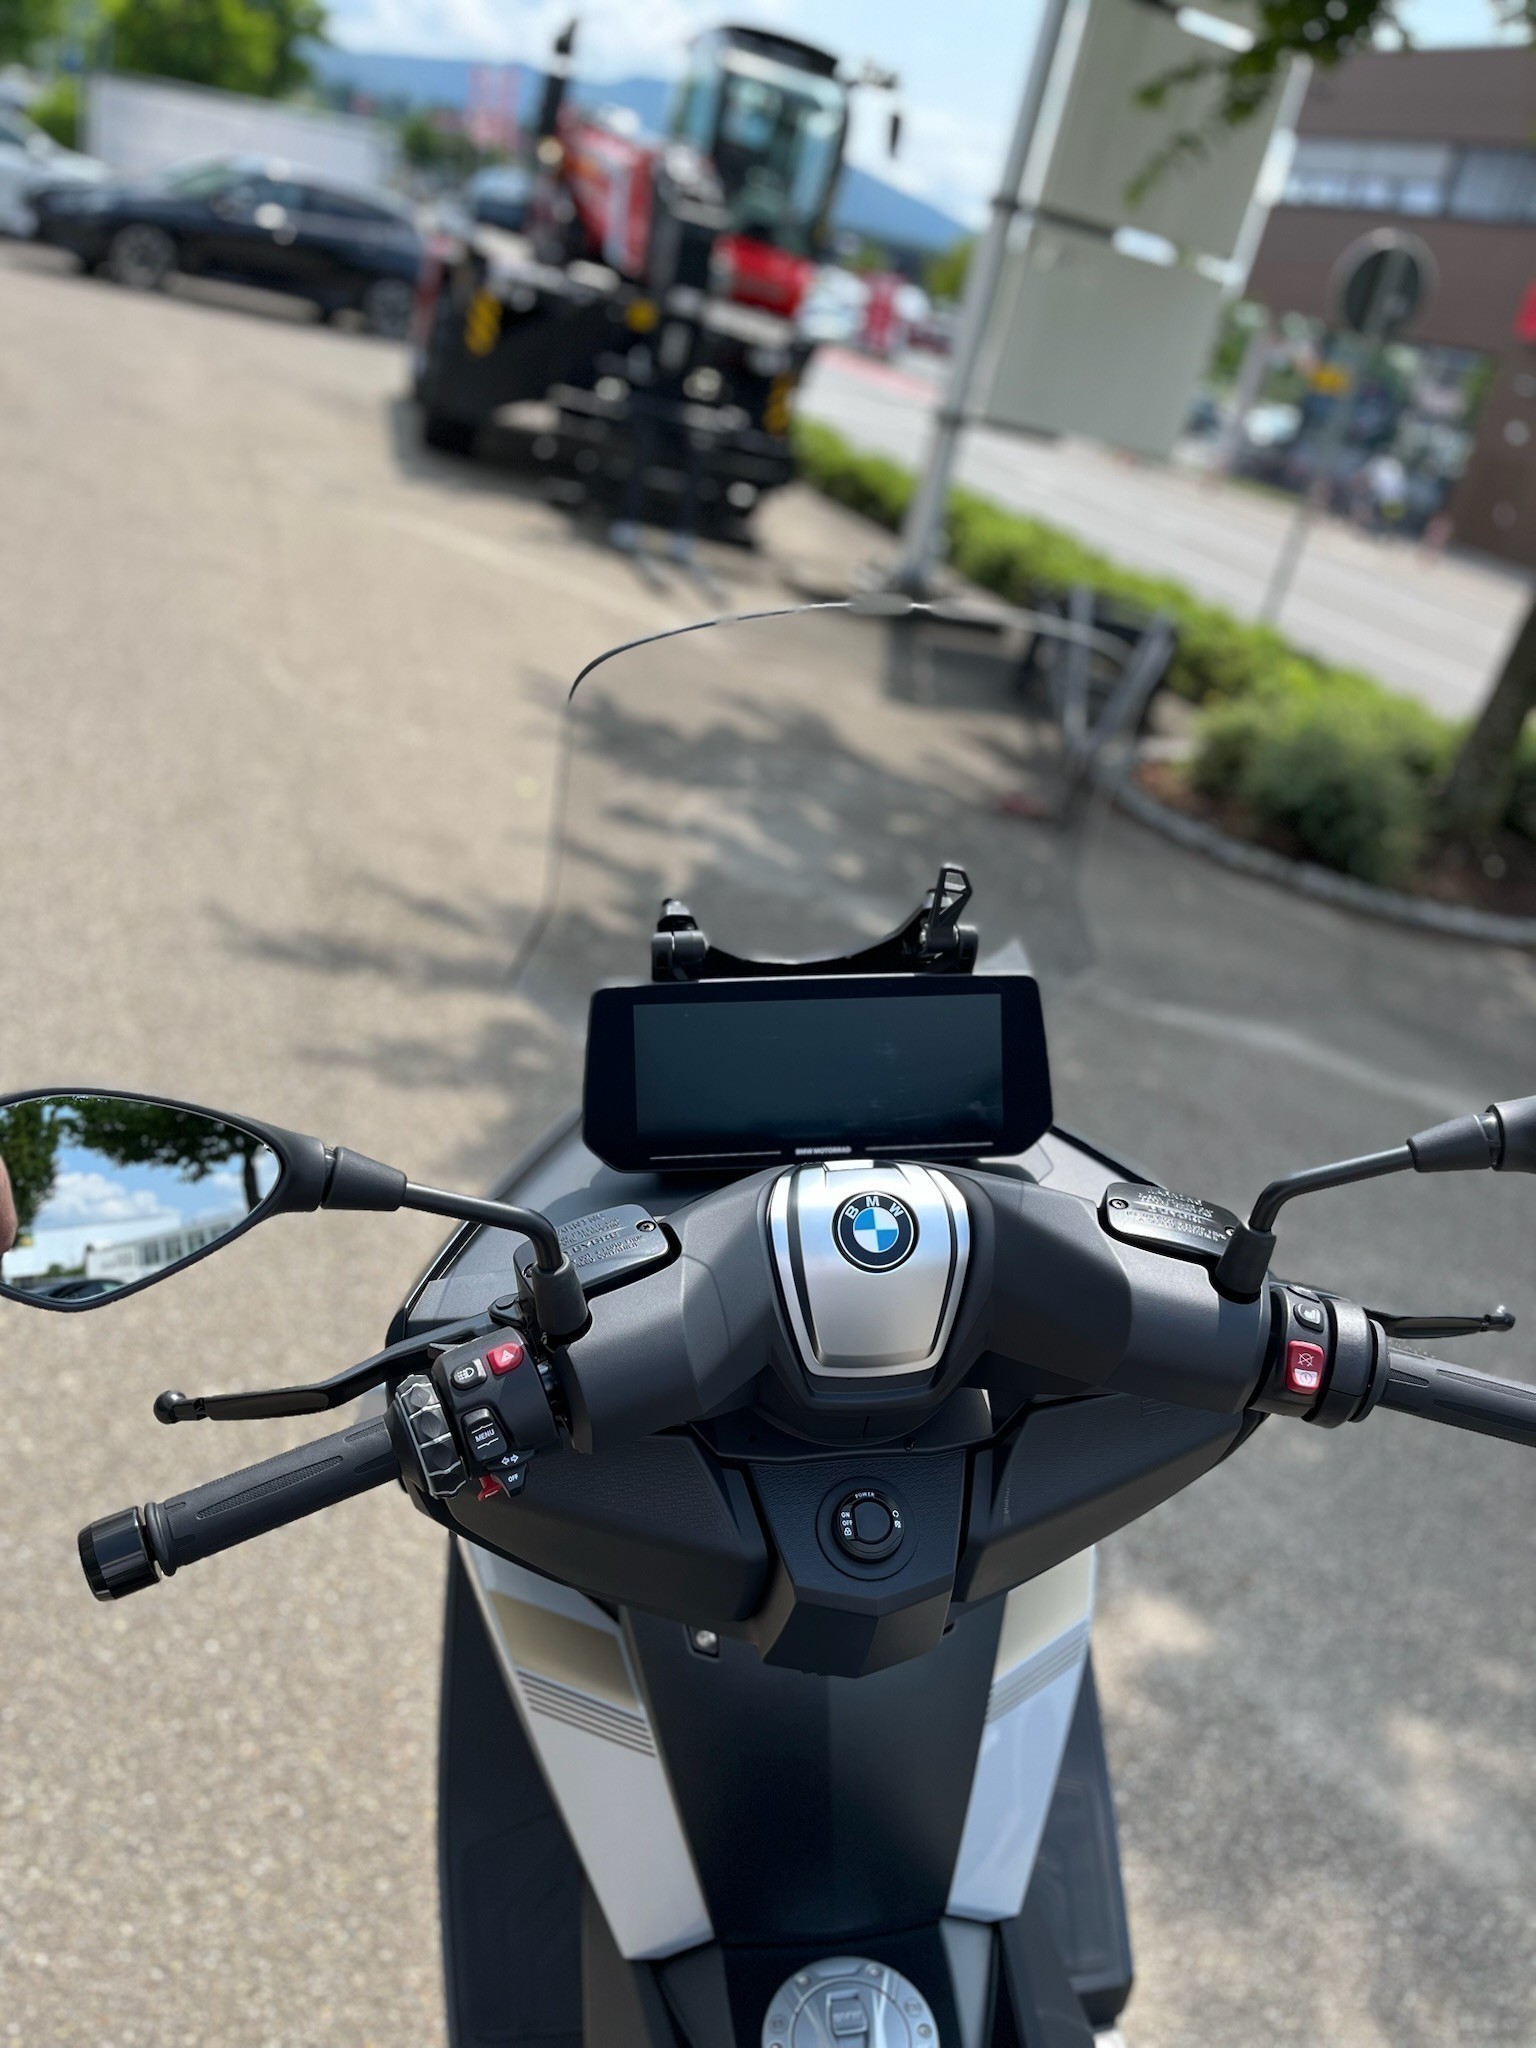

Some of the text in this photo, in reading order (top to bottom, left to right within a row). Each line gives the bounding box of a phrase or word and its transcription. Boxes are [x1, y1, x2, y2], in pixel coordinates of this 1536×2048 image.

[795, 1146, 852, 1156] BMW MOTORRAD
[844, 1195, 904, 1220] BMW
[475, 1429, 495, 1442] MENU
[508, 1473, 518, 1482] OFF
